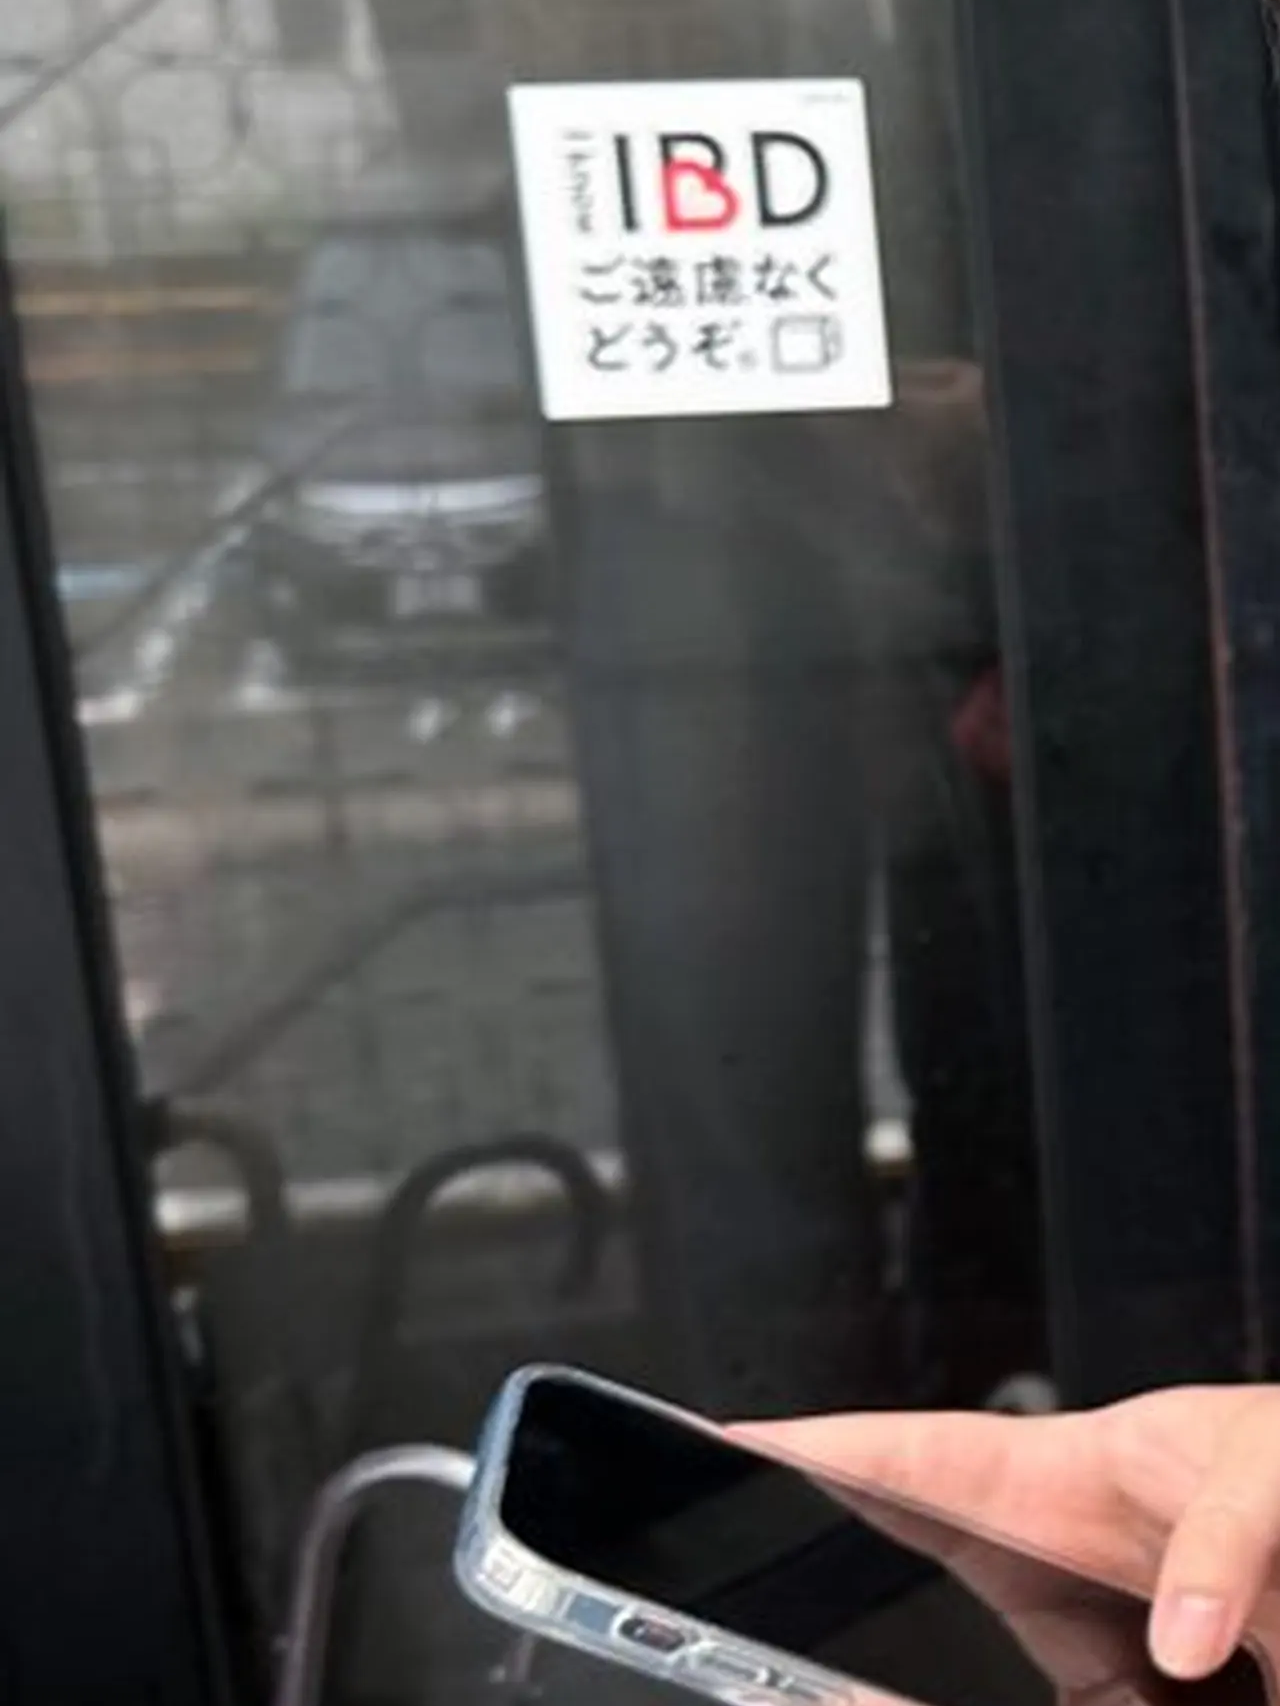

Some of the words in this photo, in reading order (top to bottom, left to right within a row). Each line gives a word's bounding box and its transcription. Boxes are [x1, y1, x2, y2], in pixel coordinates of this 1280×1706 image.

[612, 130, 832, 233] IBD
[578, 254, 839, 307] ご遠慮なく
